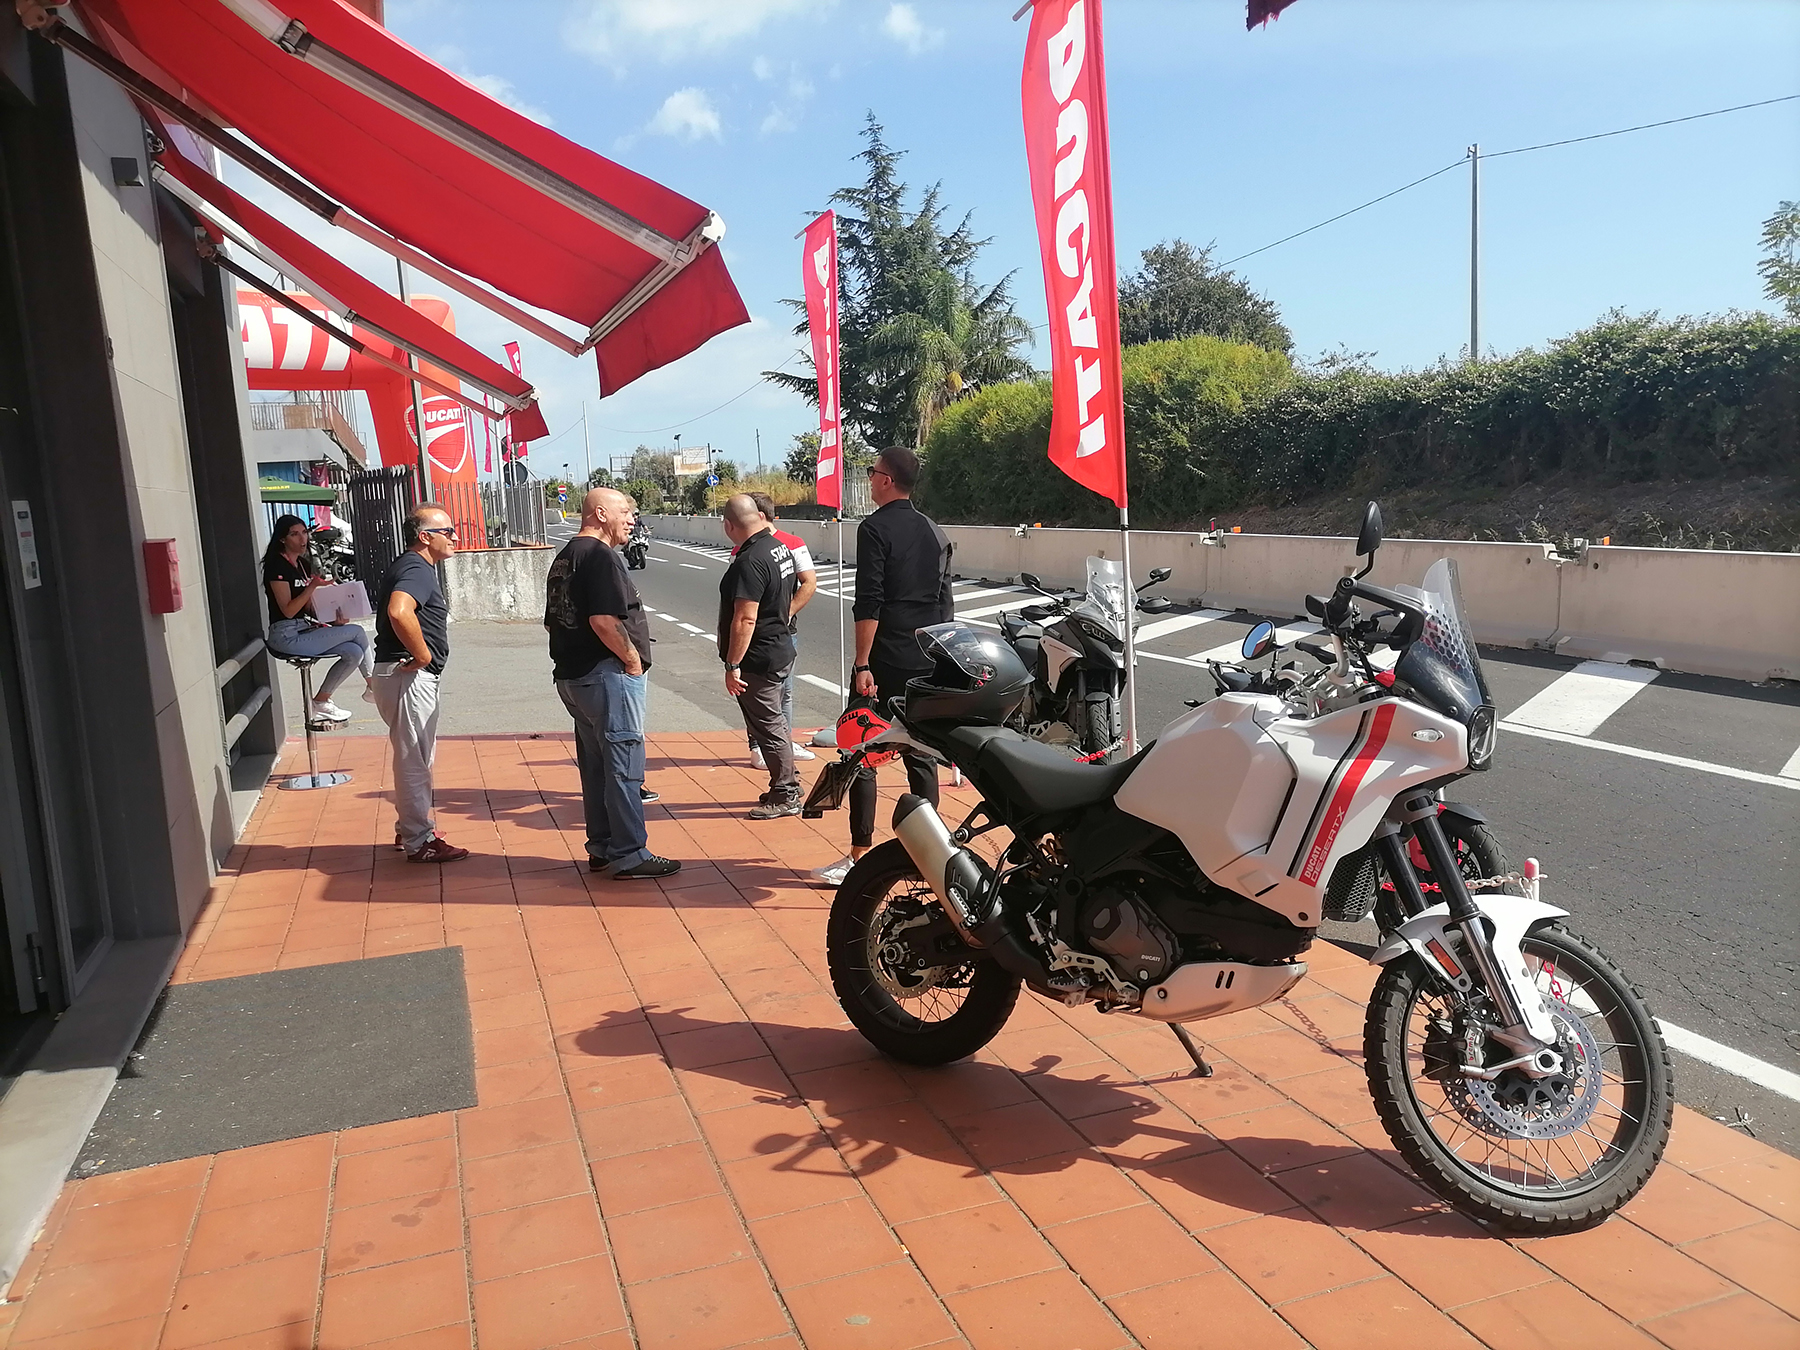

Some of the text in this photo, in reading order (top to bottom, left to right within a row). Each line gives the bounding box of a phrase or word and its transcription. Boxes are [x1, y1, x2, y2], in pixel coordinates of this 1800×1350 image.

[238, 304, 353, 371] ATI
[423, 407, 462, 423] UCATI
[1310, 806, 1345, 882] DESERTX
[1304, 845, 1321, 878] DUCATI
[1140, 954, 1161, 962] DUCATI
[1468, 1032, 1476, 1061] brembo
